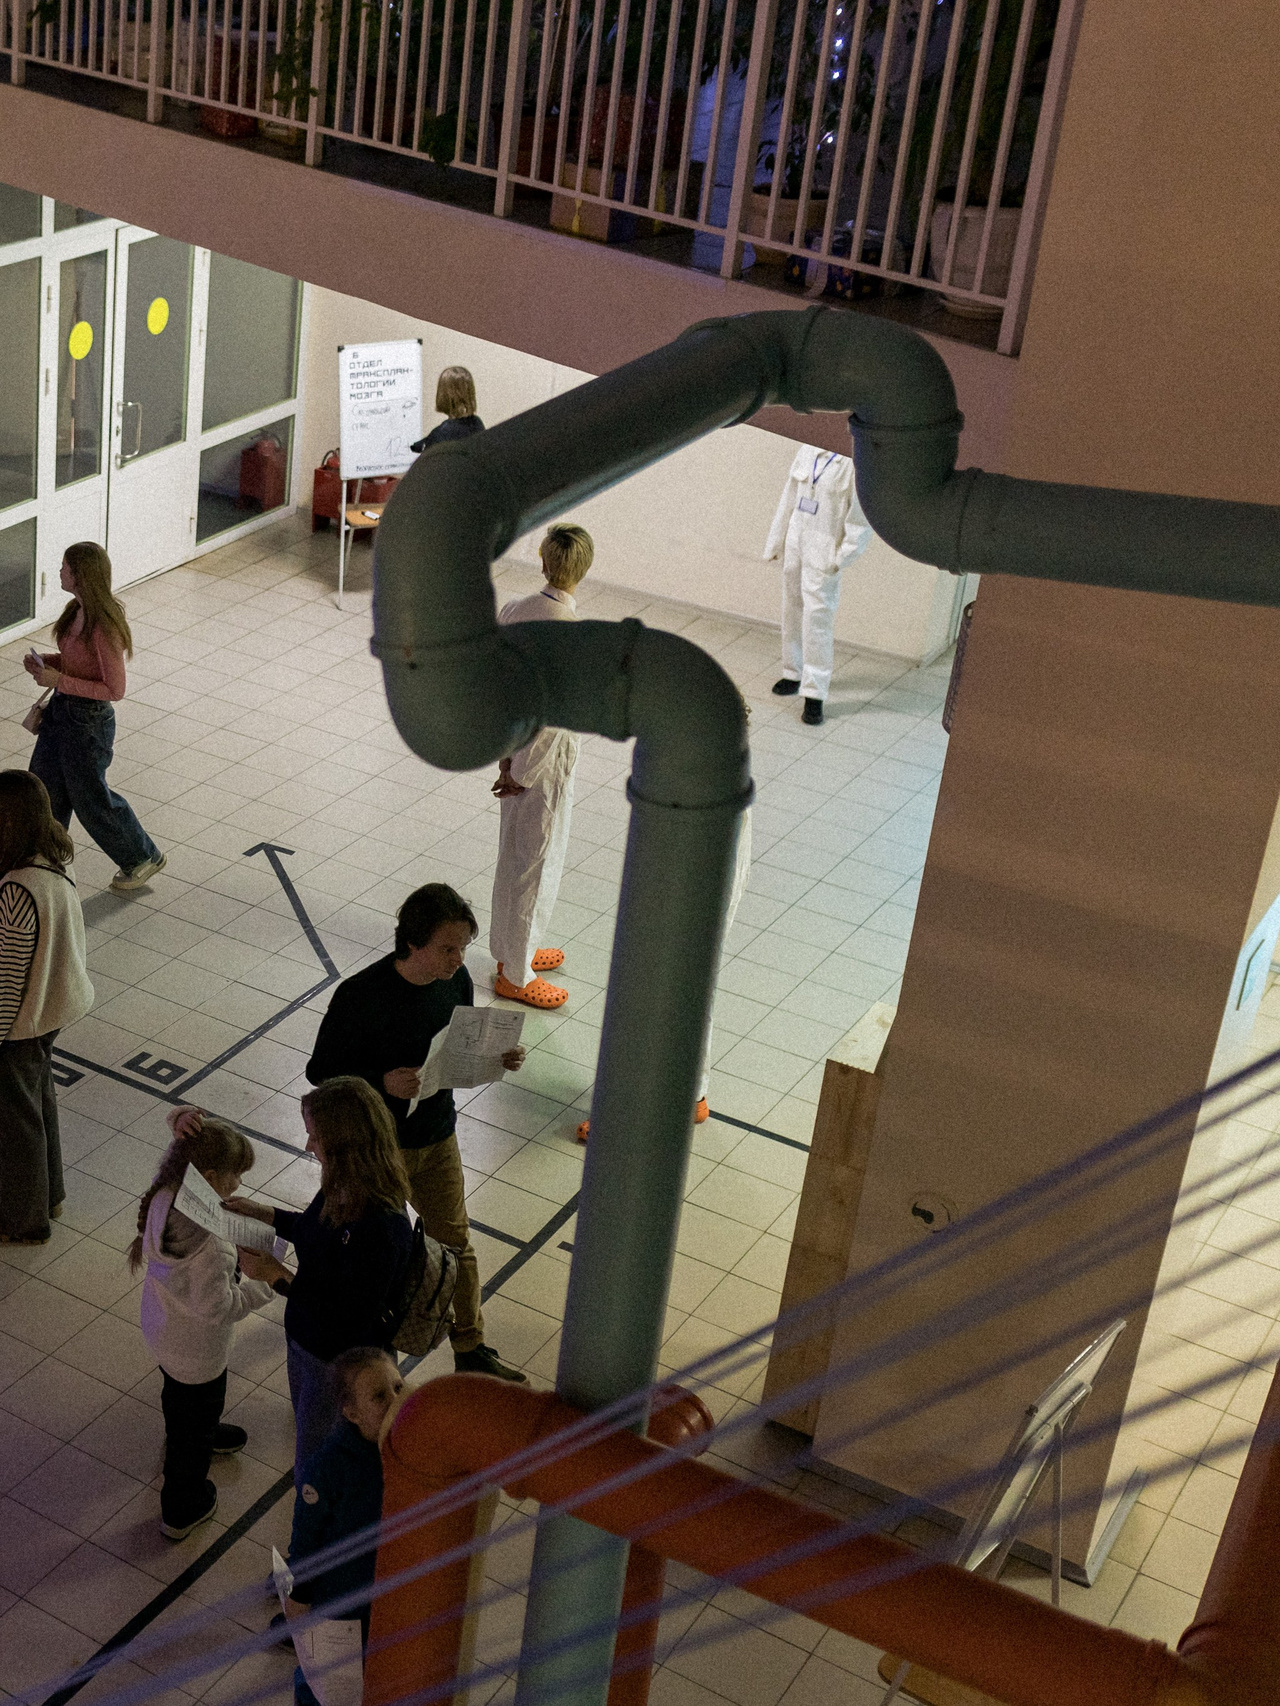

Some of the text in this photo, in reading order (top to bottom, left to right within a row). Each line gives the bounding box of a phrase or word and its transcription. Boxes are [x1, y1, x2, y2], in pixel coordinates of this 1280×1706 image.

[349, 359, 383, 370] ОТДЕЛ
[350, 379, 396, 390] ТОЛОГИИ
[349, 390, 384, 400] МОЗГА
